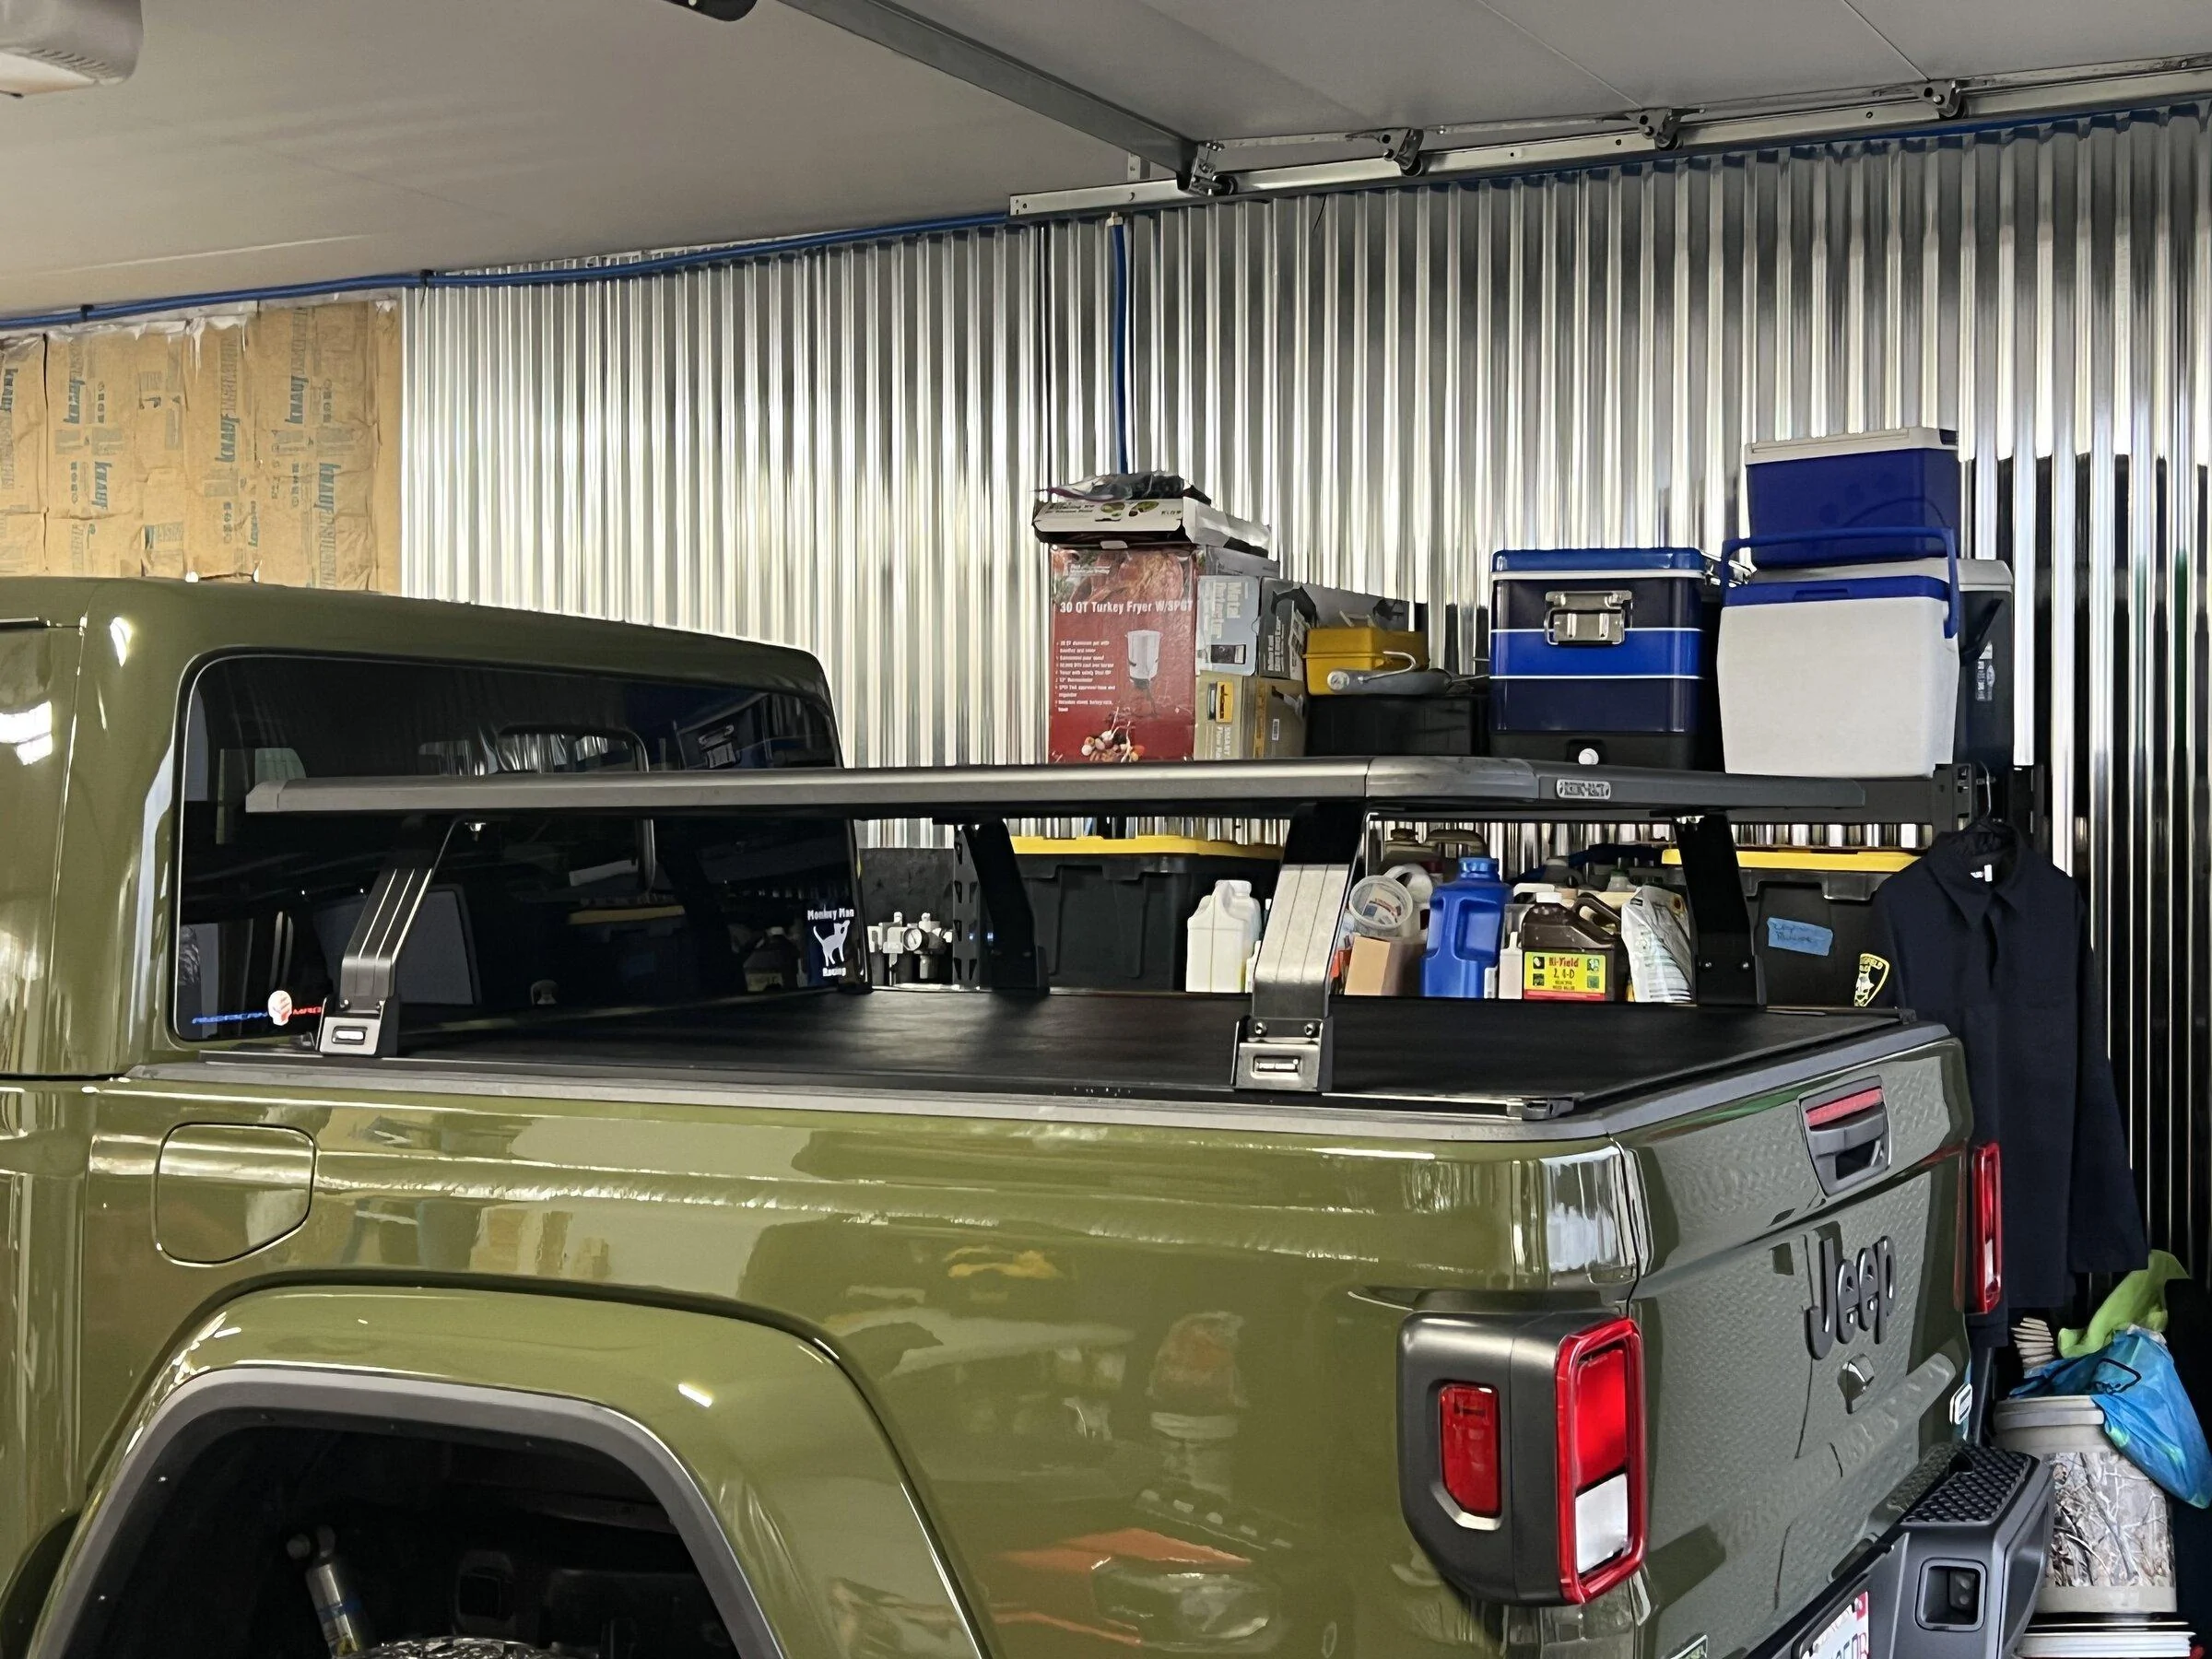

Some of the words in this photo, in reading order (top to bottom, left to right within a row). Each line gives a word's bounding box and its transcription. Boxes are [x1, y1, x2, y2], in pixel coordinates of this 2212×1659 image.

[1060, 601, 1073, 613] 30
[1076, 602, 1088, 614] QT
[1091, 600, 1124, 615] Turkey
[1126, 600, 1152, 615] Fryer
[806, 904, 837, 921] Monkey
[838, 908, 854, 918] Man
[1804, 1235, 1897, 1360] Jeep
